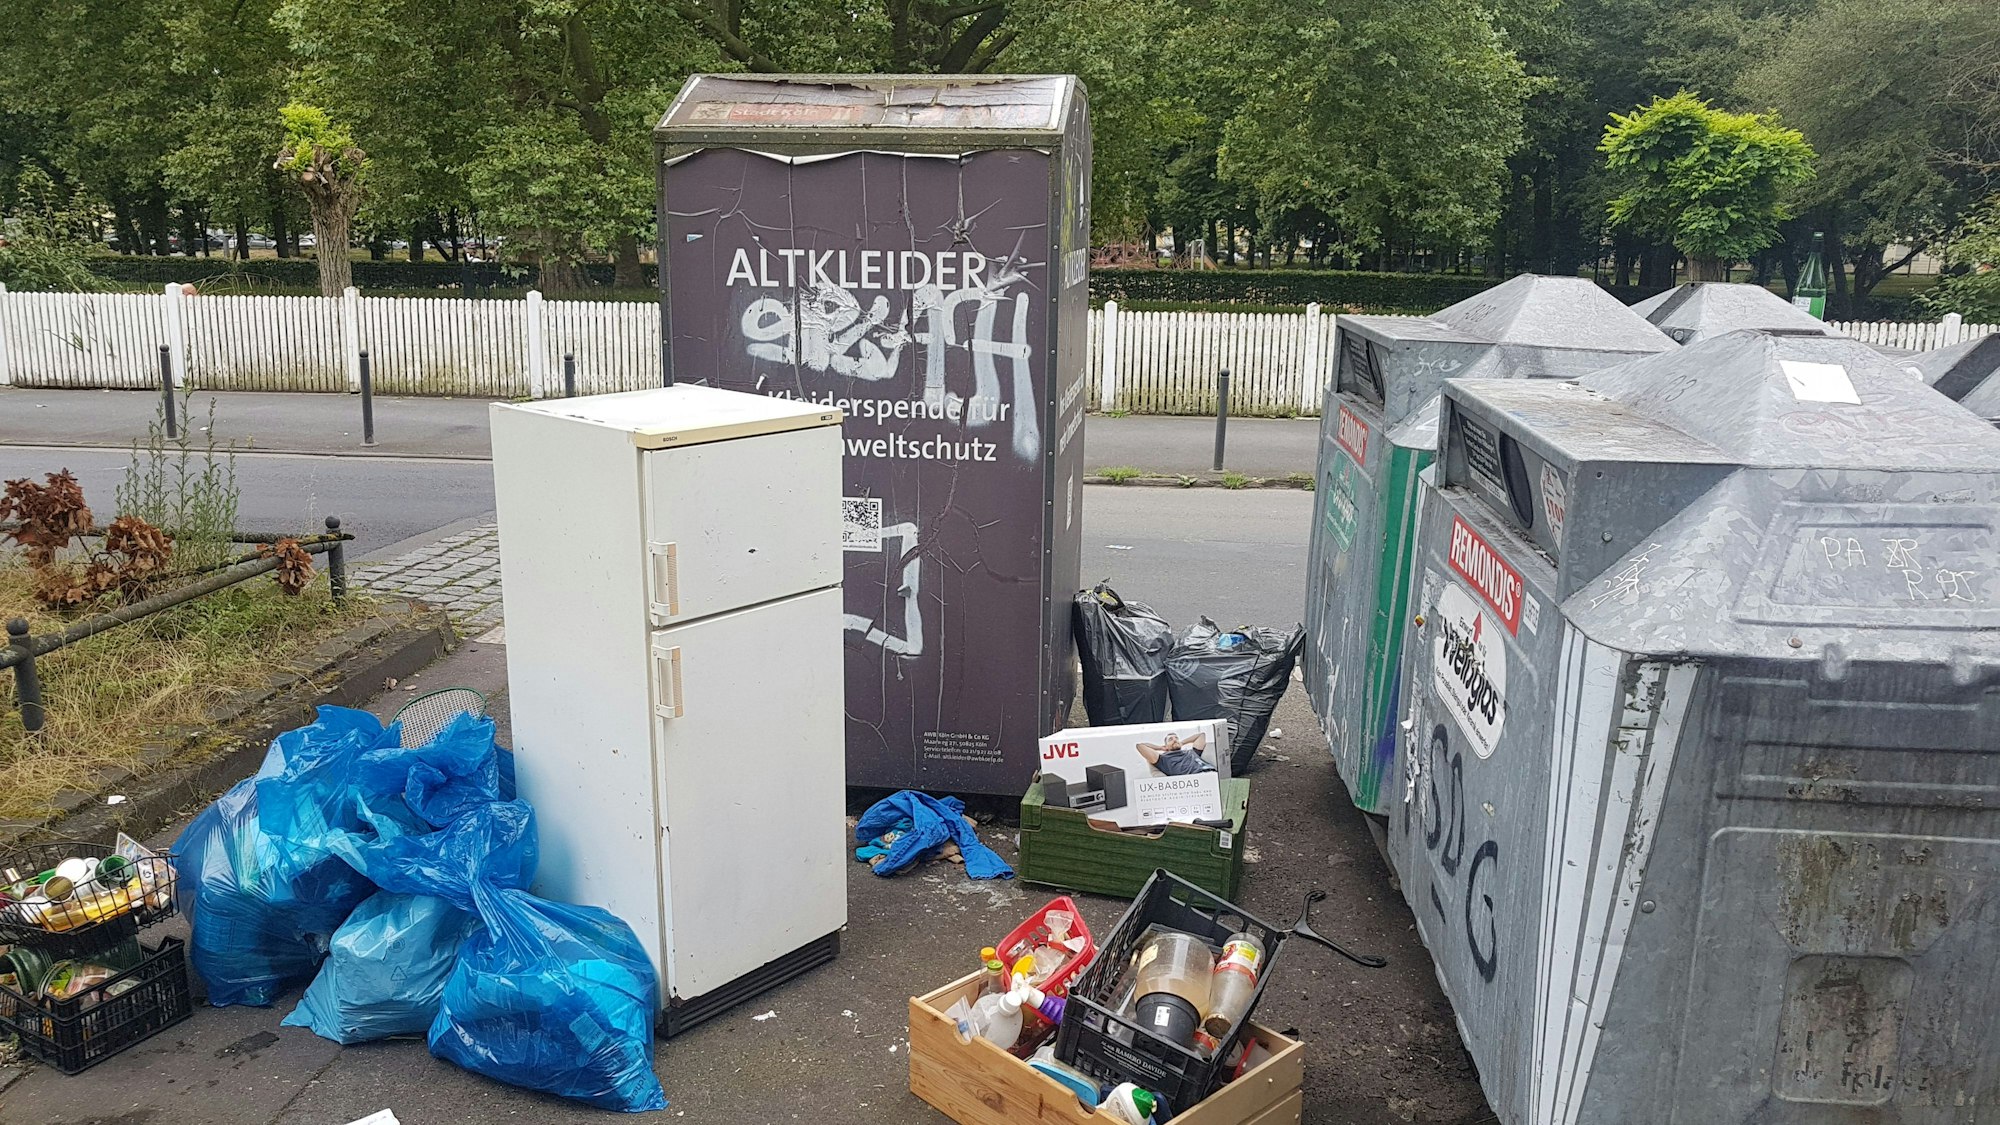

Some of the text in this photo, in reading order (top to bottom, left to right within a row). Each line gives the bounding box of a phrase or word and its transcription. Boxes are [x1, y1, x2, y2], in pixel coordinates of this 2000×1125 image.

[726, 248, 986, 290] ALTKLEIDER
[768, 390, 960, 425] iderspende
[842, 433, 997, 462] weltschutz
[1043, 742, 1079, 760] JVC
[1142, 1061, 1167, 1078] DAVIDE
